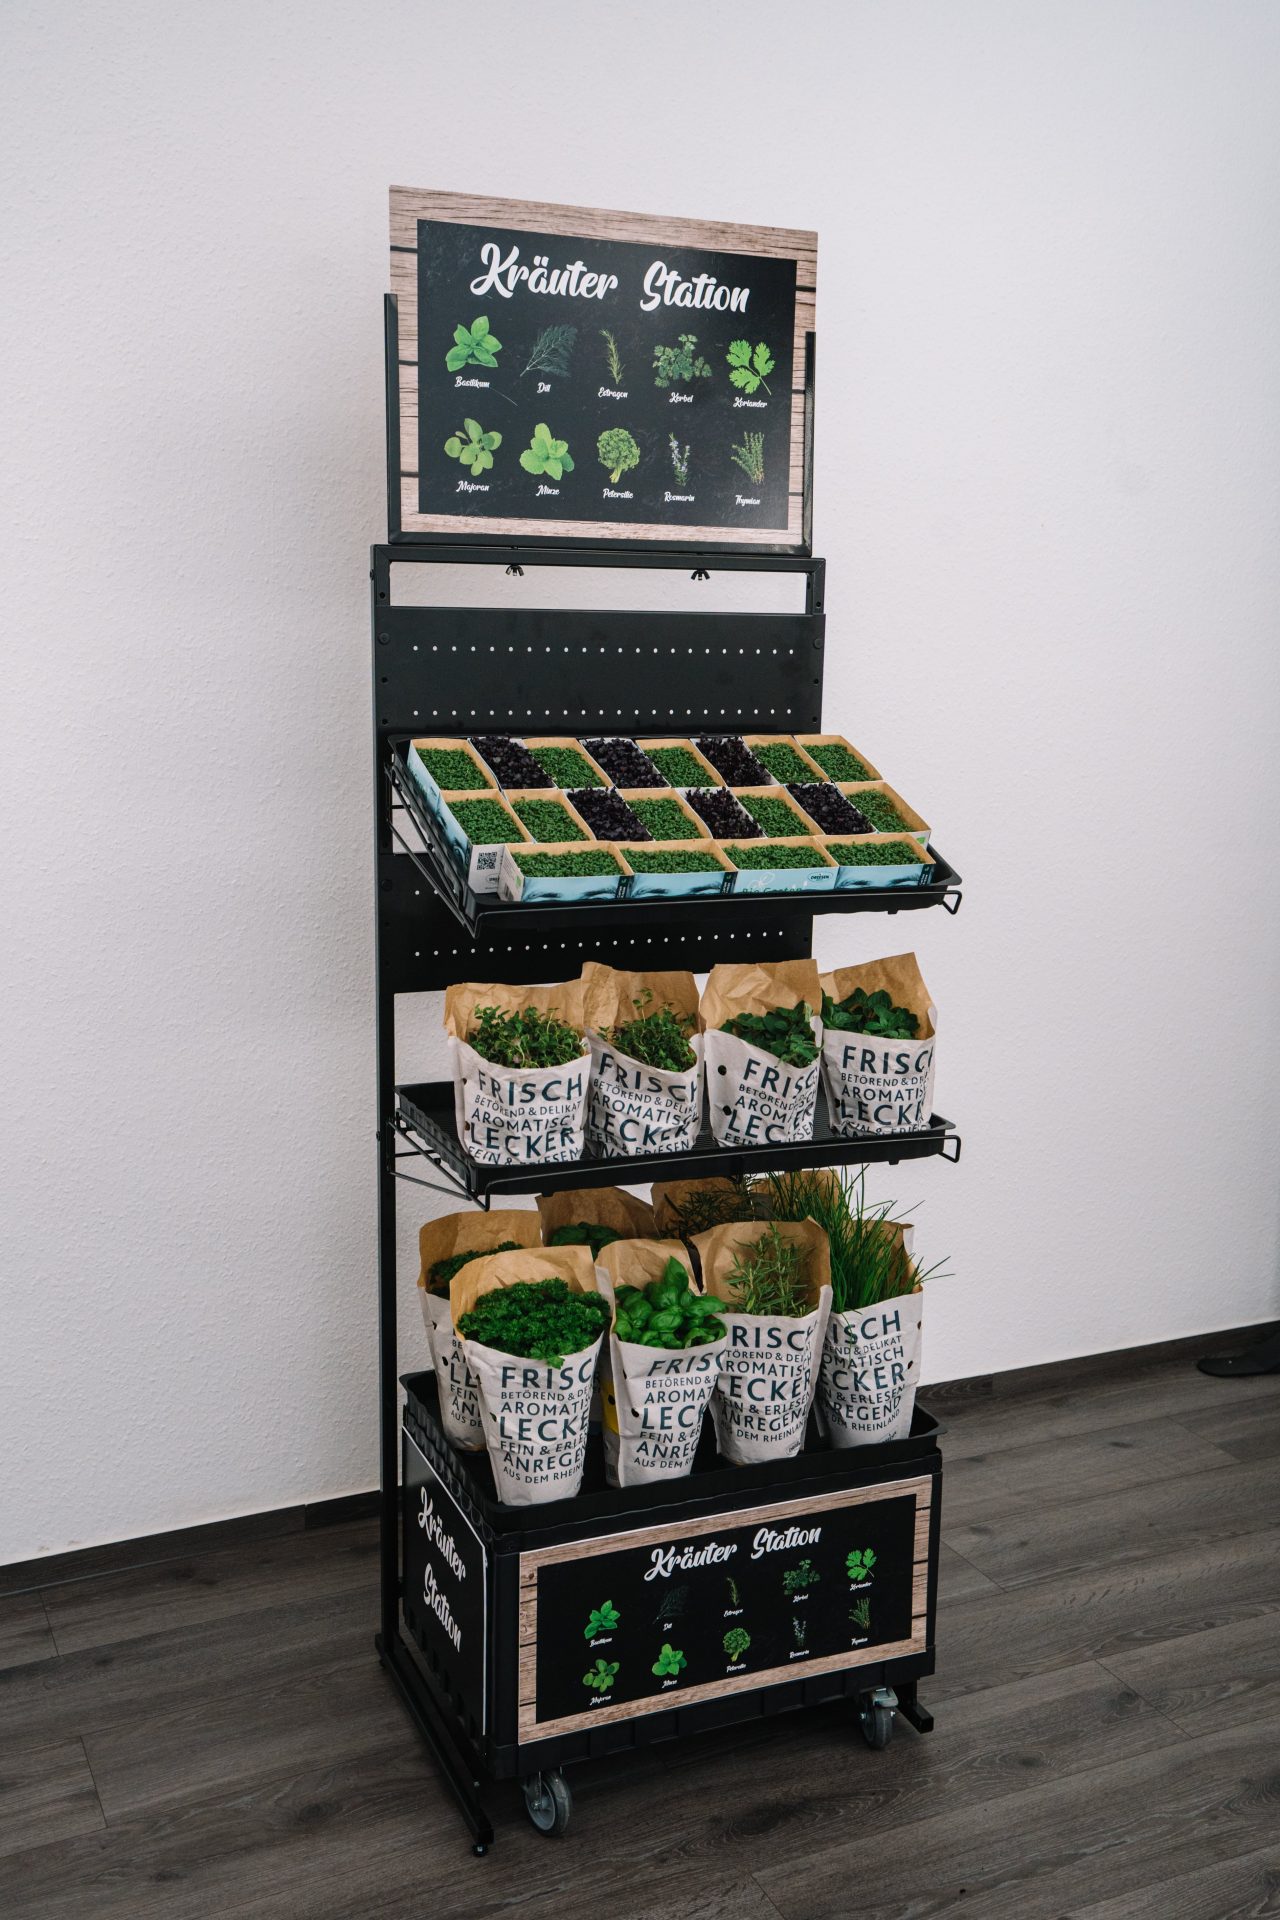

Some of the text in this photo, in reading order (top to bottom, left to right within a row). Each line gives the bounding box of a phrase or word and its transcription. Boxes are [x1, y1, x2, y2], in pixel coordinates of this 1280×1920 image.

[470, 242, 750, 313] Kräuter Station
[454, 376, 490, 389] Basilikum
[598, 387, 628, 400] Estragon
[669, 392, 693, 403] Kerbel
[733, 397, 767, 408] Koriander
[456, 480, 489, 492] Majoran
[536, 484, 560, 496] Minze
[603, 488, 633, 499] Petersilie
[664, 491, 694, 502] Rosmarin
[735, 494, 760, 507] Thymian
[479, 1070, 582, 1106] FRISCH
[743, 1058, 818, 1099] FRISC
[841, 1073, 898, 1087] BETÖREND
[594, 1079, 651, 1103] BETÖREND
[842, 1085, 924, 1102] AROMATI
[475, 1094, 525, 1118] BETÖREND
[540, 1101, 581, 1115] DELIKAT
[841, 1099, 922, 1125] LECK
[471, 1107, 575, 1132] AROMATISC
[470, 1122, 575, 1158] LECKER
[832, 1310, 901, 1344] ISCH
[726, 1349, 772, 1360] TÖREND
[864, 1335, 901, 1354] DELIKAT
[647, 1349, 726, 1376] FRISC
[822, 1346, 904, 1369] OMATISCH
[501, 1358, 594, 1390] FRISC
[646, 1376, 701, 1389] BETÖREND
[821, 1362, 905, 1391] ECKER
[501, 1390, 565, 1401] BETÖREND
[644, 1386, 713, 1404] AROMAT
[851, 1384, 905, 1405] ERLESEN
[749, 1405, 759, 1414] &
[829, 1396, 901, 1421] REGEND
[500, 1408, 589, 1441] LECKE
[852, 1409, 899, 1431] RHEINLAND
[640, 1431, 673, 1443] FEIN
[737, 1429, 758, 1441] DEM
[500, 1441, 534, 1456] FEIN
[540, 1446, 550, 1455] &
[503, 1462, 583, 1484] AUS DEM RHEIN
[634, 1457, 655, 1468] AUS
[660, 1460, 682, 1469] DEM
[418, 1486, 466, 1583] Kräuter
[643, 1525, 822, 1582] Kräuter Station
[423, 1562, 462, 1653] Station
